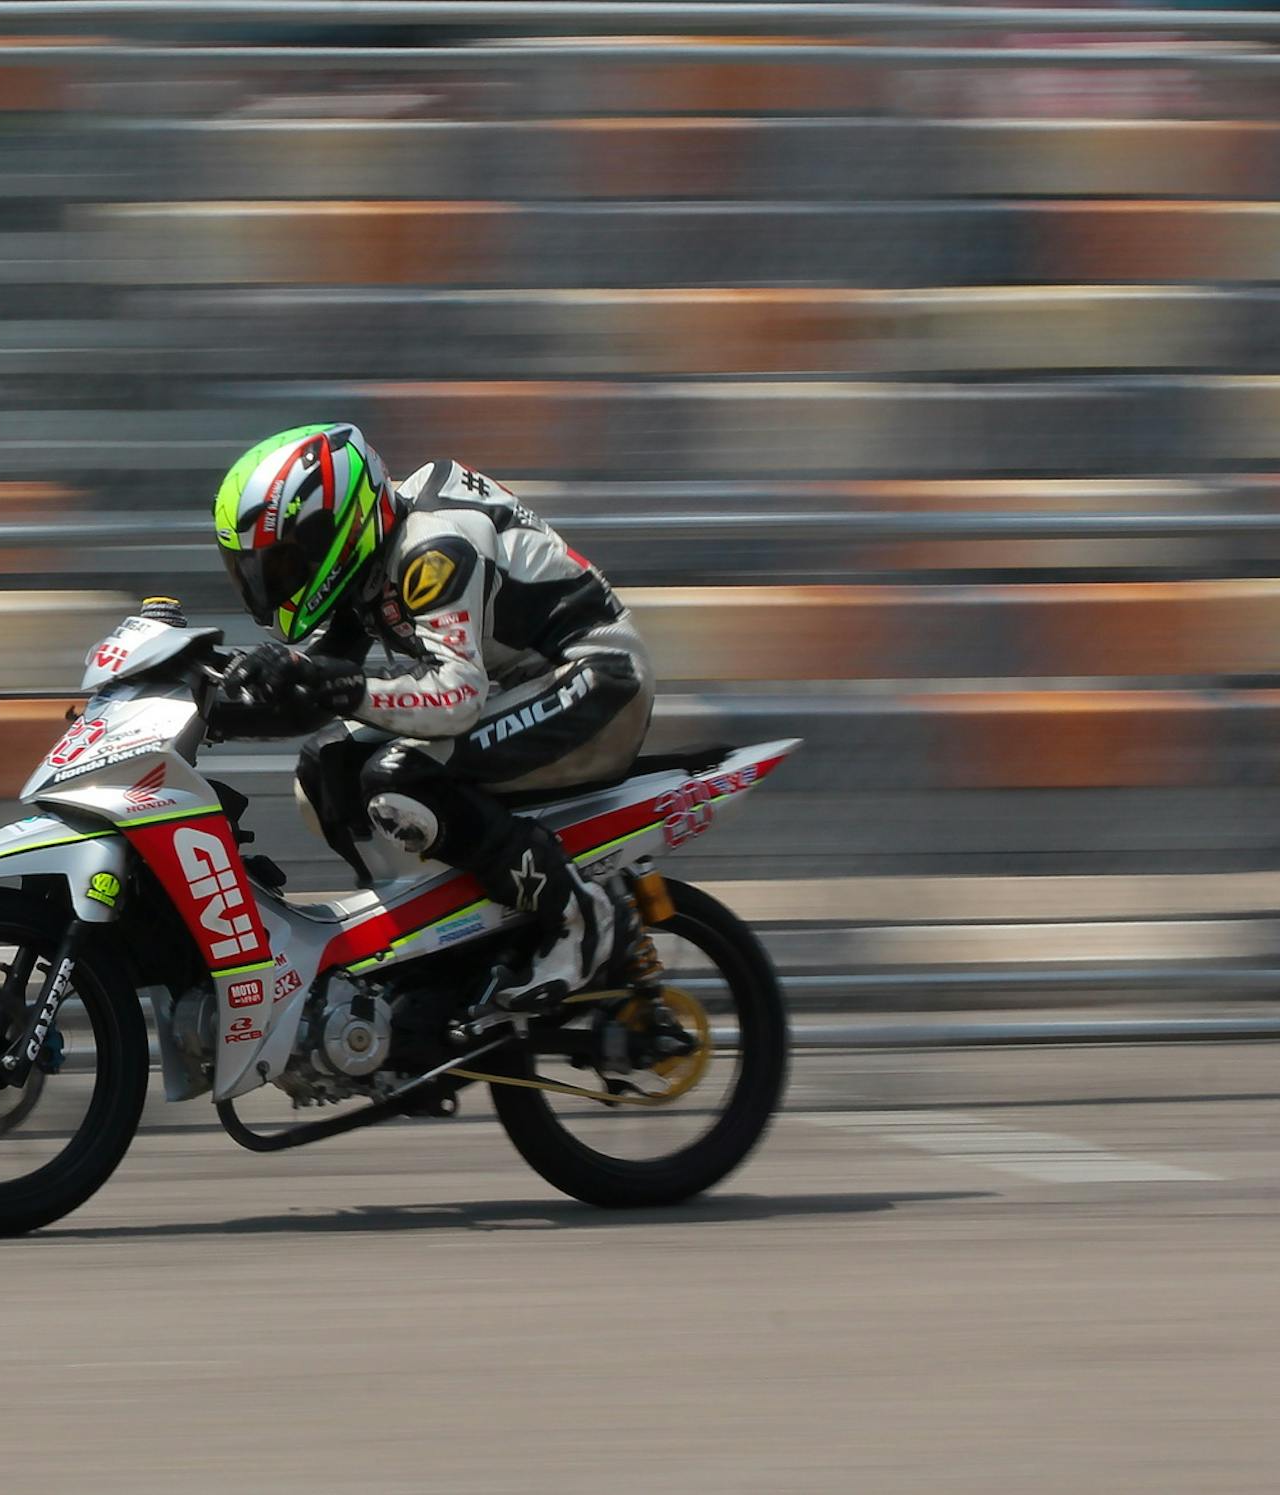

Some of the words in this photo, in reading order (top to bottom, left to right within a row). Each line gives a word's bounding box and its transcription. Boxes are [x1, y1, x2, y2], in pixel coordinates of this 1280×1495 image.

[370, 683, 480, 709] HONDA
[470, 667, 595, 750] TAICHI
[126, 798, 177, 813] HONDA
[173, 827, 258, 960] GIVI
[231, 982, 259, 998] MOTO
[27, 958, 75, 1061] GALFER
[224, 1030, 264, 1045] RCB
